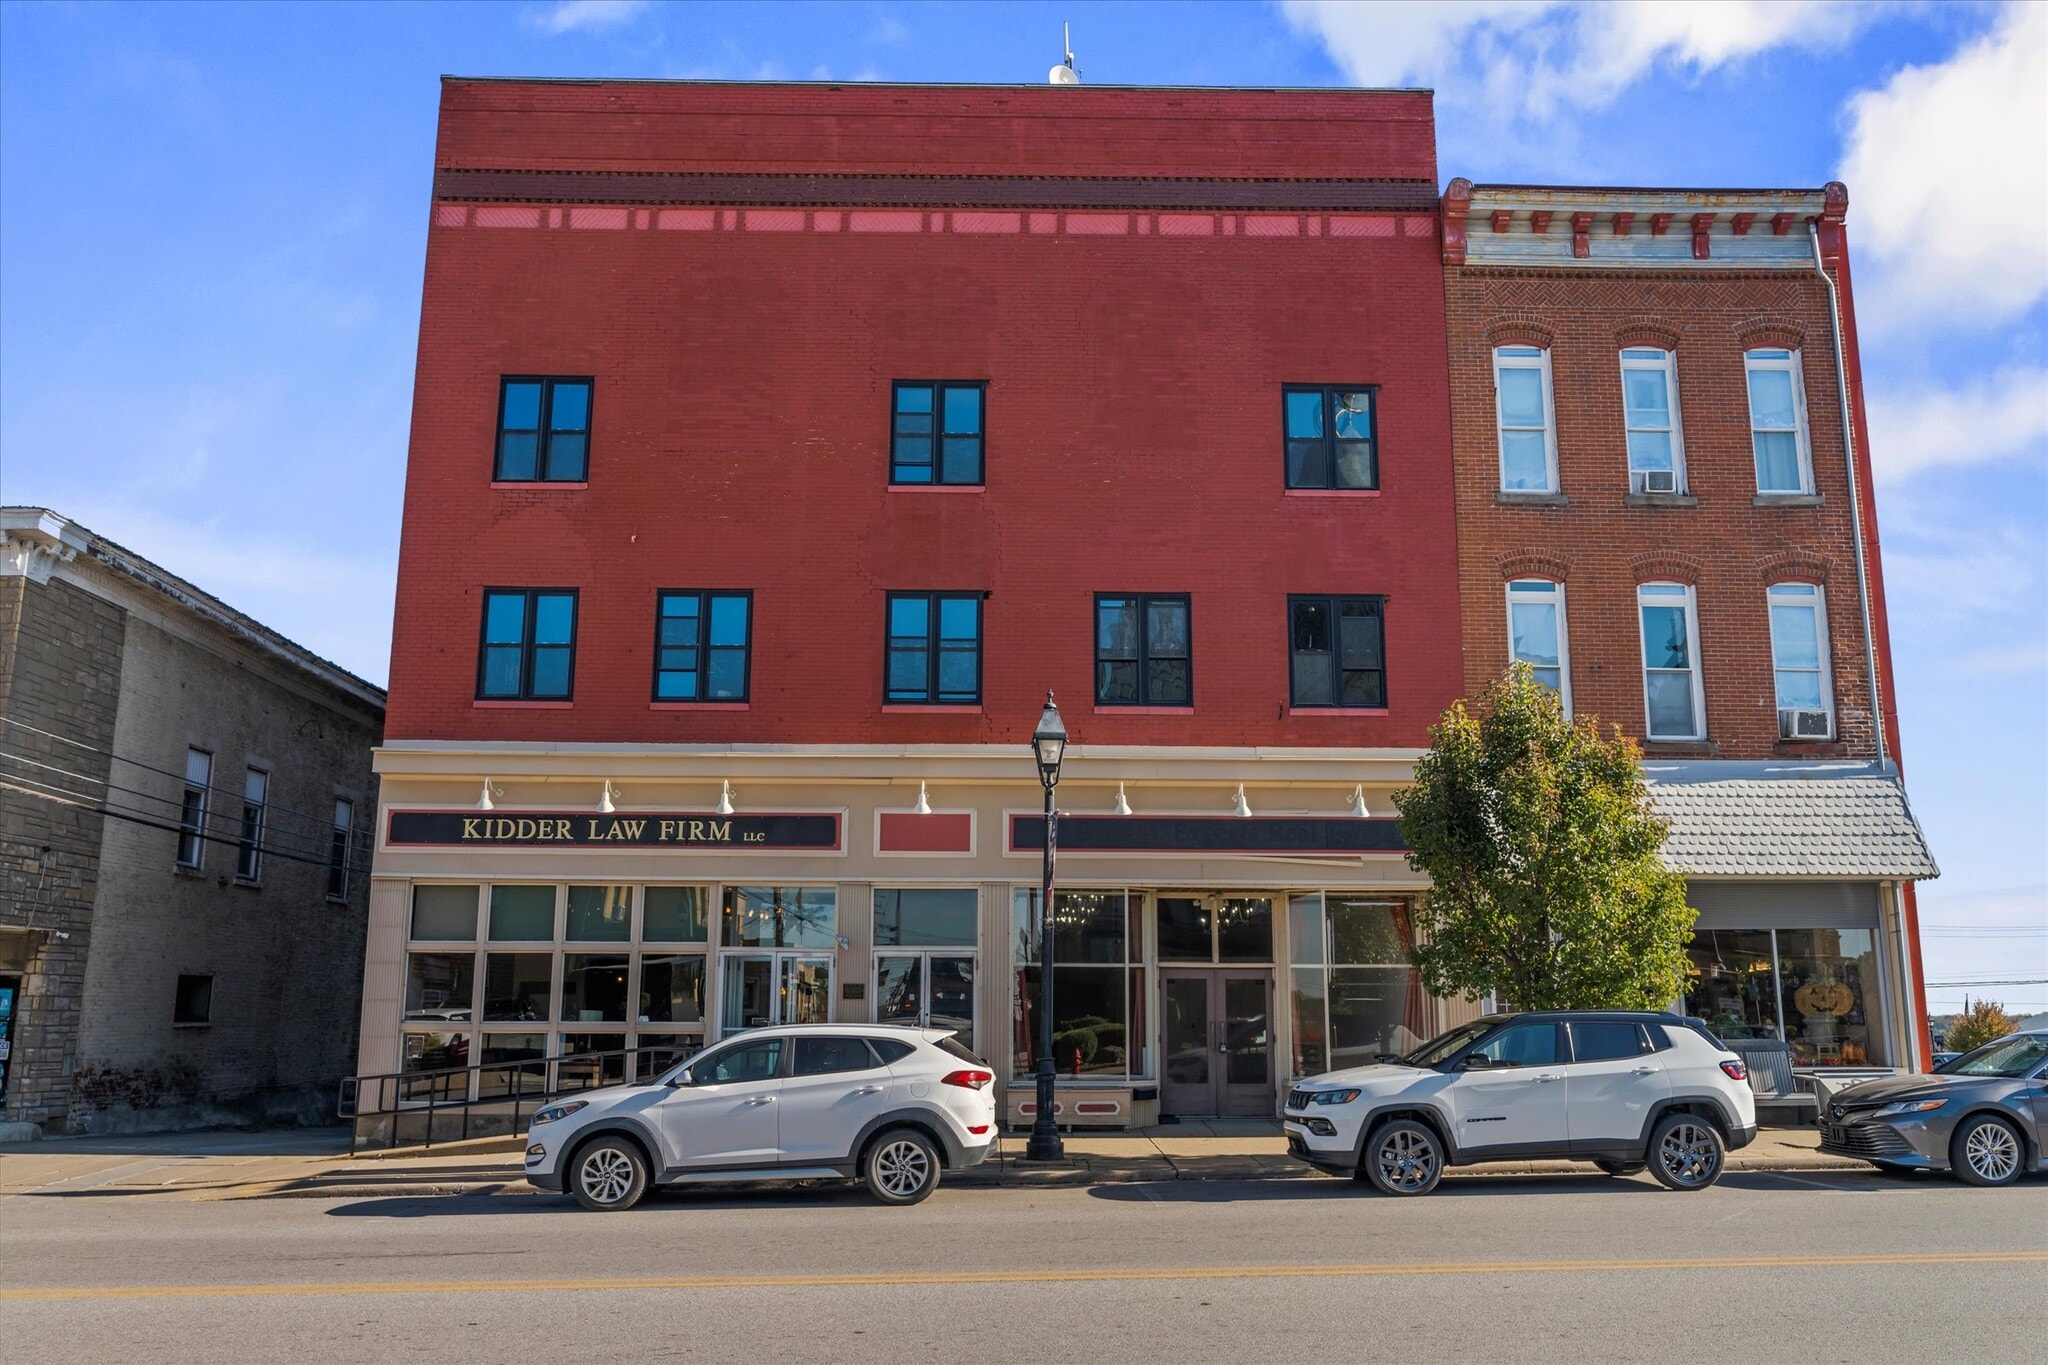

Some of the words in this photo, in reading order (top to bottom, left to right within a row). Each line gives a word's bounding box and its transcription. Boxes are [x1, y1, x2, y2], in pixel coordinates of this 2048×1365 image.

[461, 818, 574, 840] KIDDER
[587, 819, 648, 840] LAW
[658, 820, 733, 841] FIRM
[743, 832, 766, 842] LLC
